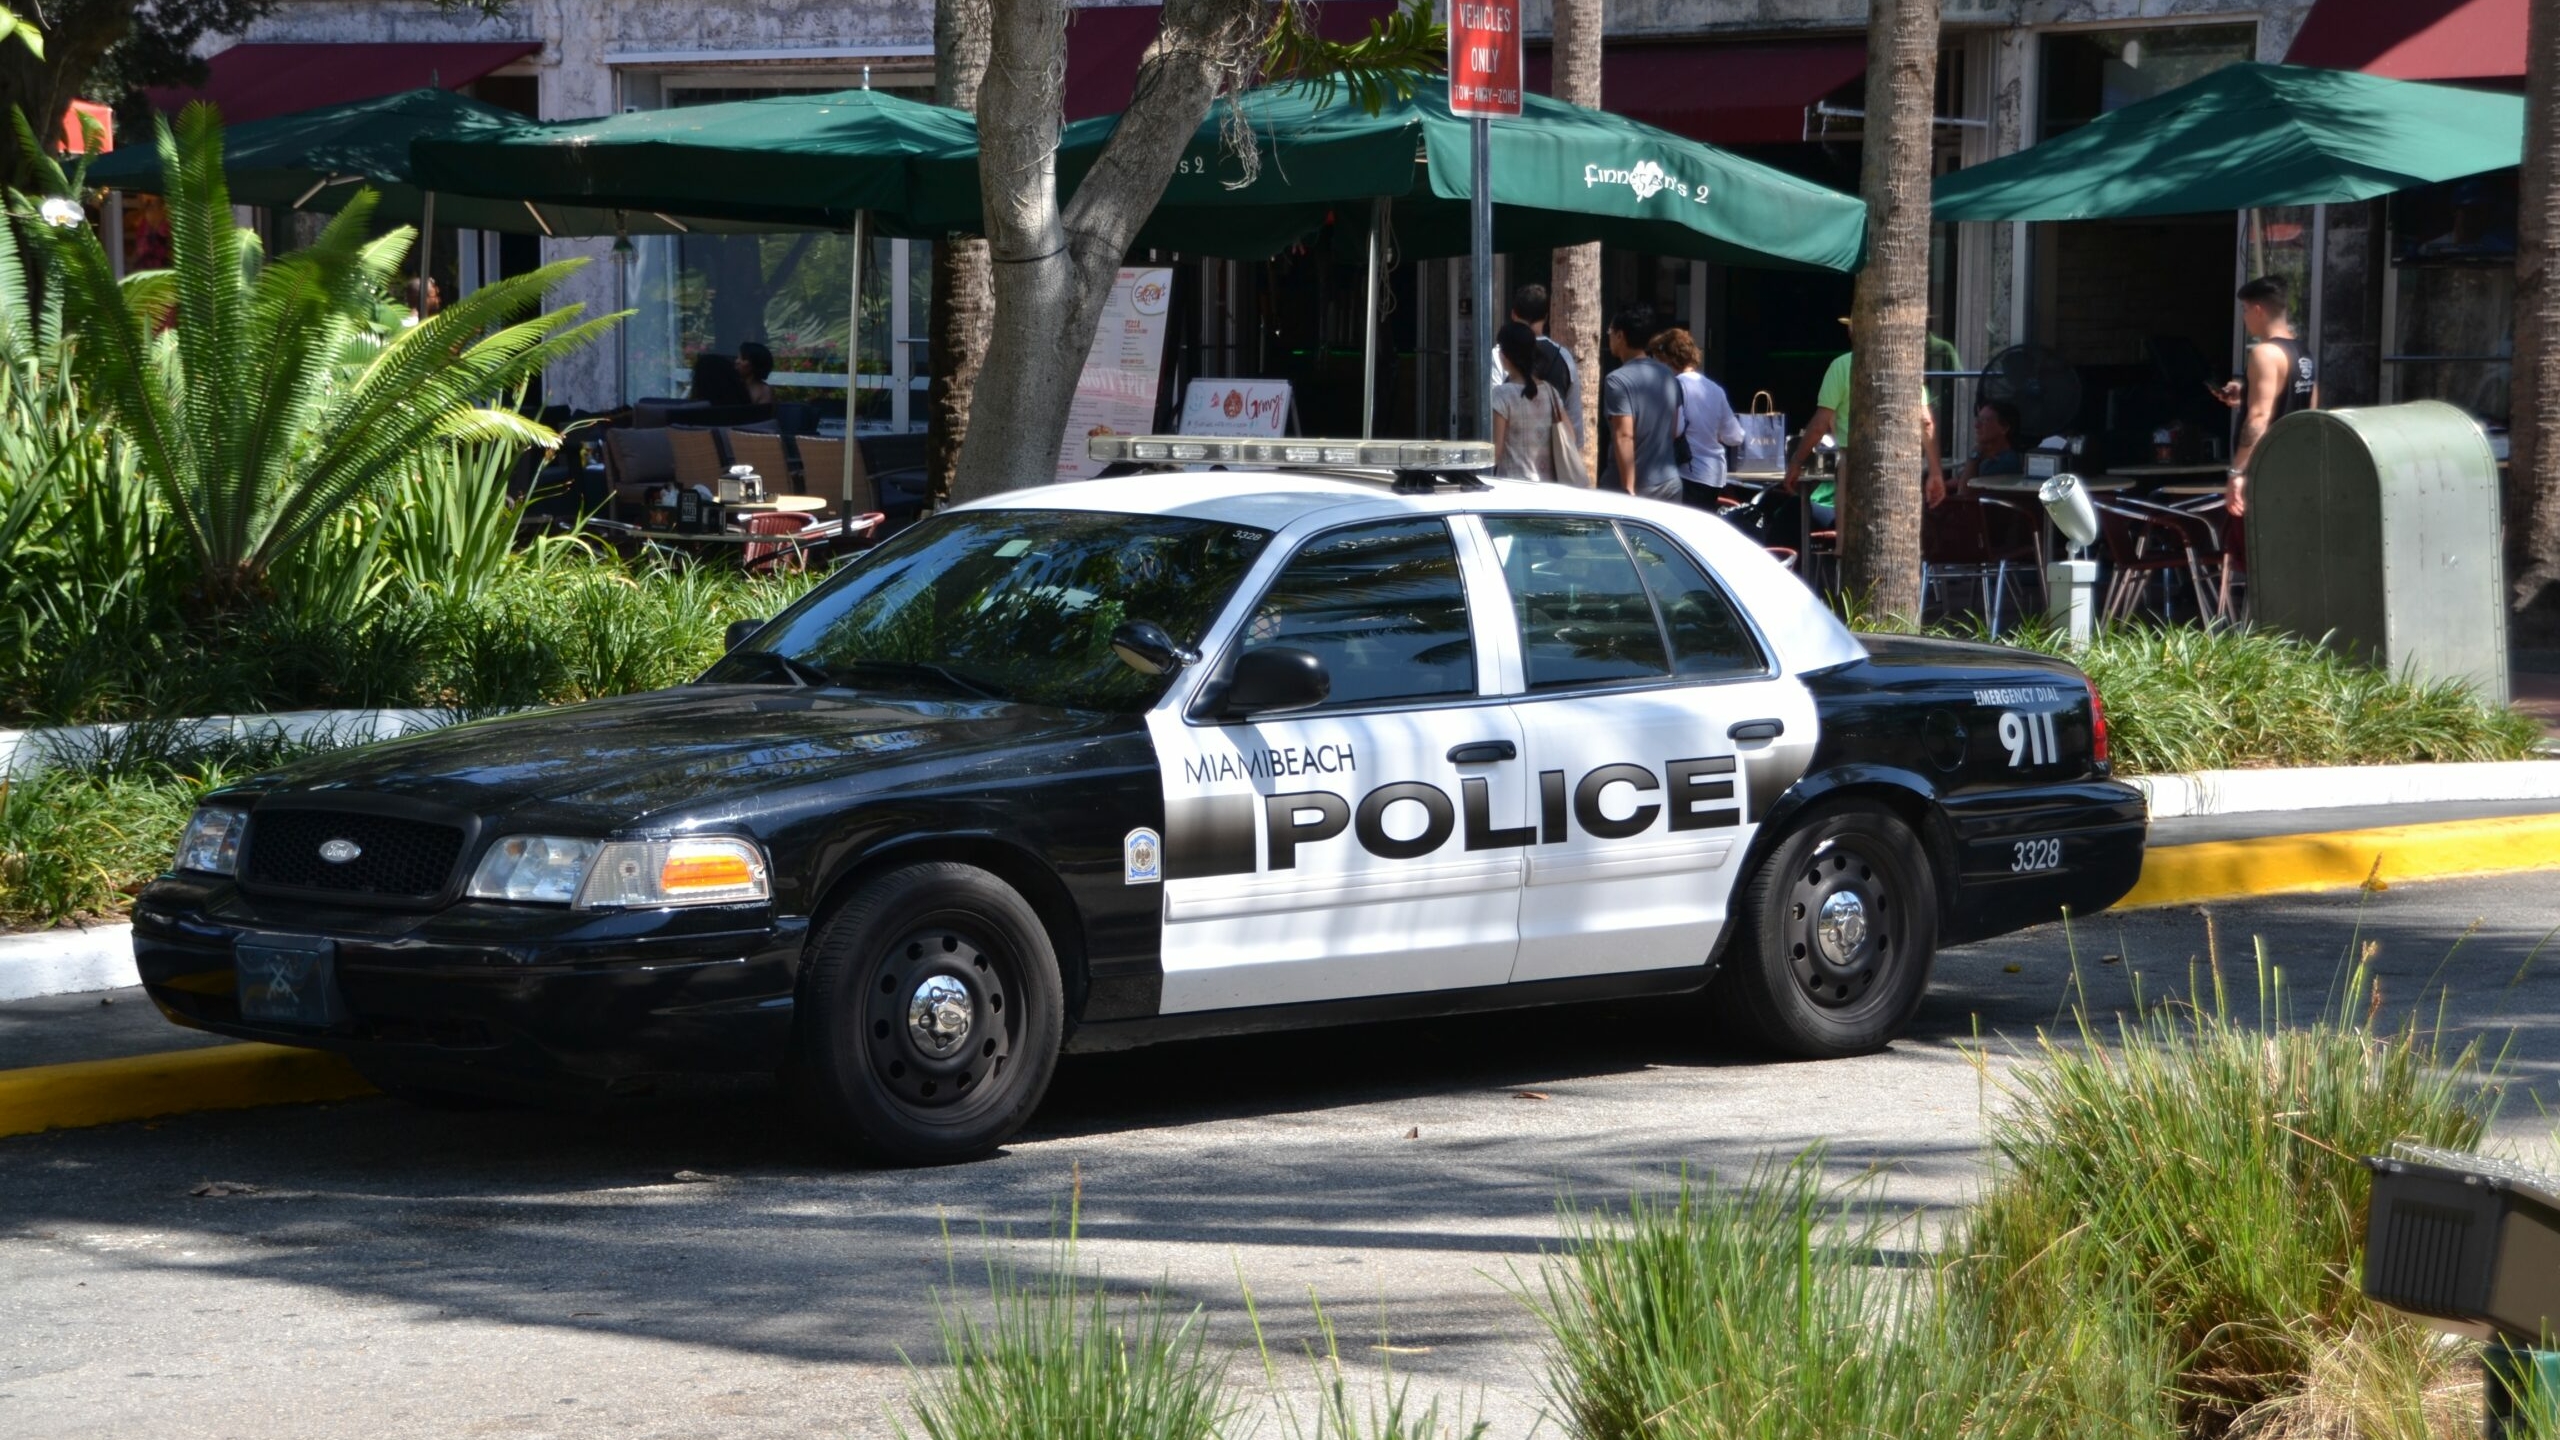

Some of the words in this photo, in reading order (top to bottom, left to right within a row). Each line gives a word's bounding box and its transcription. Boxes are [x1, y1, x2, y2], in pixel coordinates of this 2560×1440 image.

[1459, 3, 1511, 33] VEHICLES
[1471, 47, 1499, 73] ONLY
[1693, 184, 1709, 204] 2
[1232, 529, 1263, 541] 3328
[1973, 687, 2034, 706] EMERGENCY
[2035, 686, 2060, 702] DIAL
[1998, 712, 2057, 767] 911
[1264, 755, 1741, 872] POLICE
[2011, 838, 2060, 872] 3328
